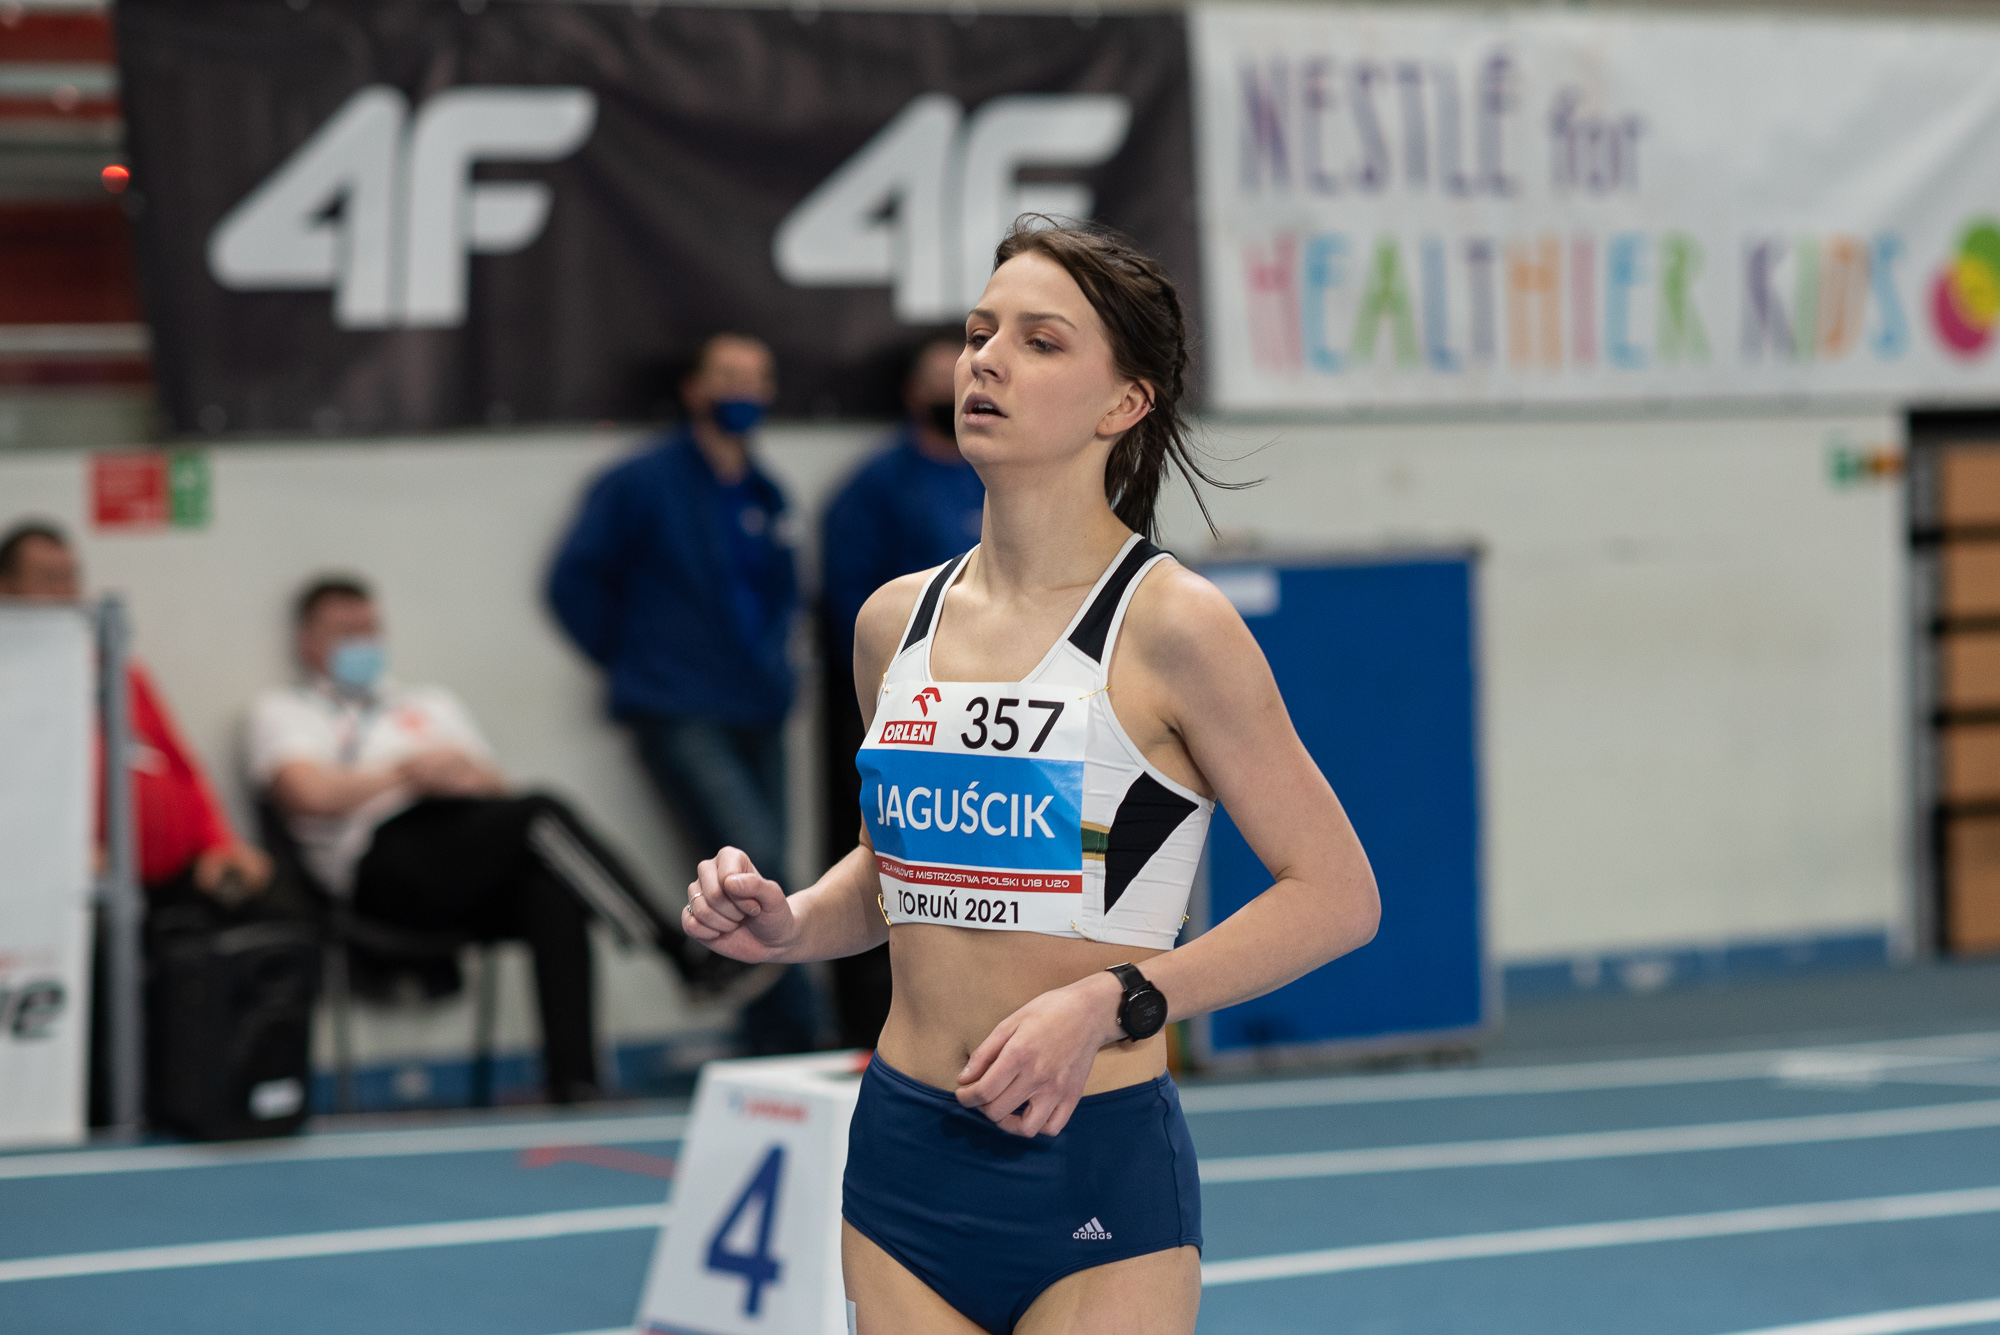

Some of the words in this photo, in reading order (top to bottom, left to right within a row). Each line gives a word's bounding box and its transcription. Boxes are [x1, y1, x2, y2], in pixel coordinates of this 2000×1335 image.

[1237, 45, 1520, 198] NESTLÉ
[1548, 88, 1647, 194] for
[206, 85, 598, 329] 4F
[773, 93, 1132, 323] 4F
[1243, 230, 1711, 373] HEALTHIER
[1740, 229, 1910, 366] KIDS
[883, 723, 933, 743] ORLEN
[960, 696, 1065, 753] 357
[877, 781, 1056, 839] JAGUŚCIK
[898, 889, 957, 919] TORUŃ
[964, 897, 1019, 923] 2021
[915, 870, 980, 884] MISTRZOSTWA
[981, 875, 1019, 887] POLSKI
[1021, 878, 1043, 888] U18
[1045, 879, 1070, 889] U20
[705, 1142, 786, 1318] 4
[1072, 1230, 1113, 1240] adidas
